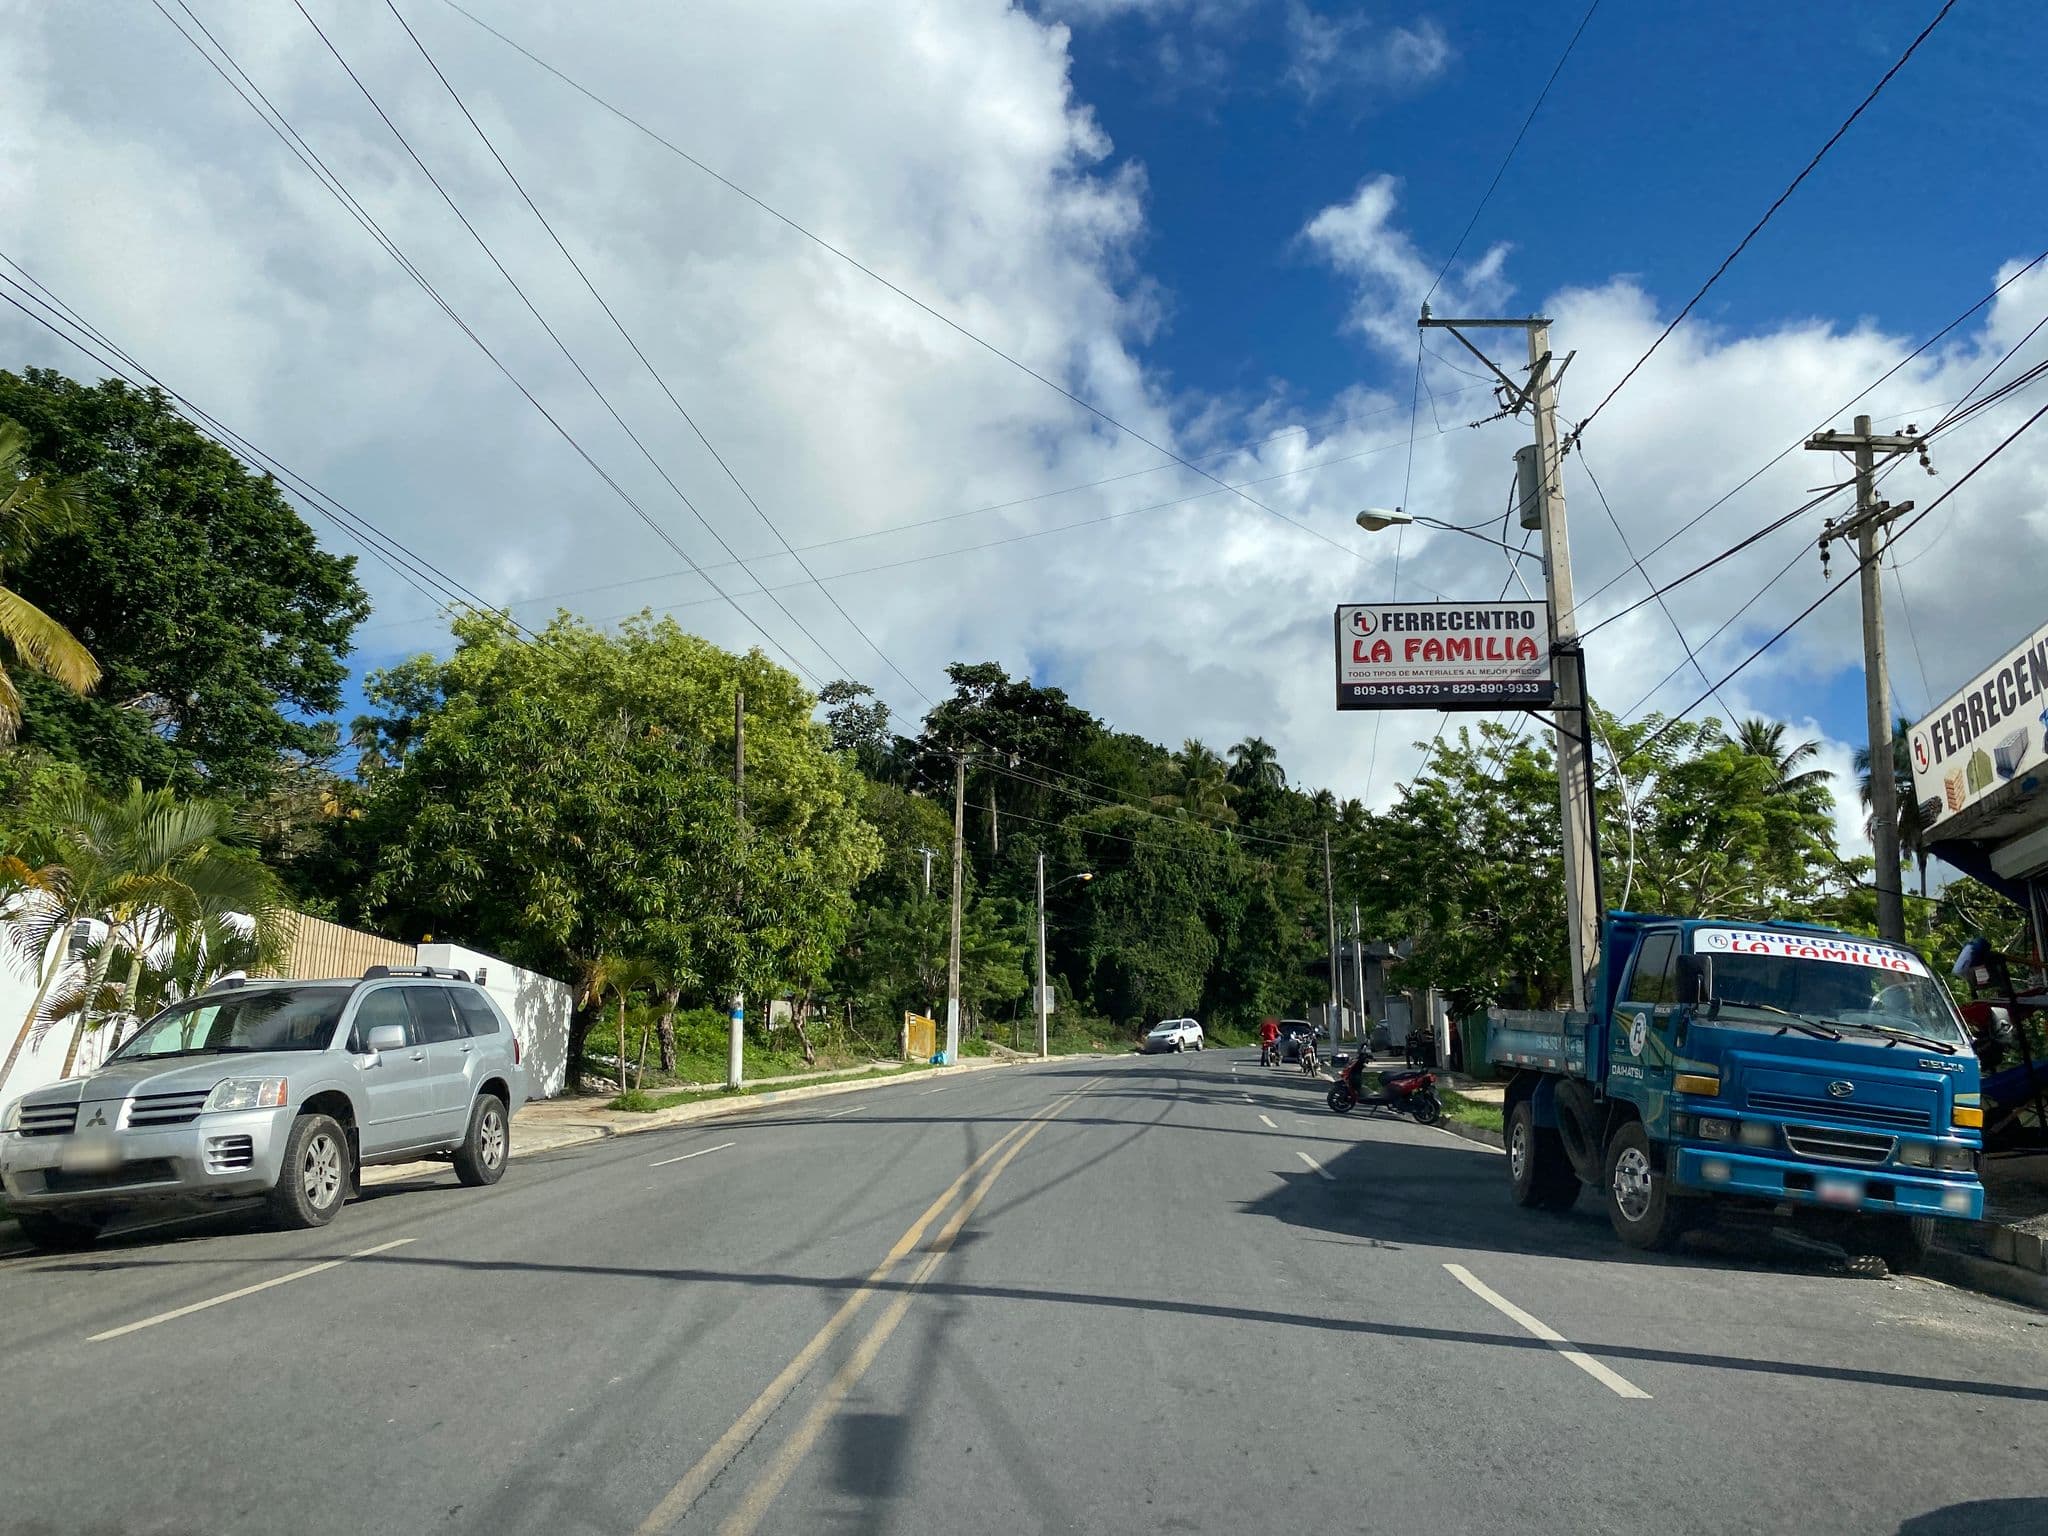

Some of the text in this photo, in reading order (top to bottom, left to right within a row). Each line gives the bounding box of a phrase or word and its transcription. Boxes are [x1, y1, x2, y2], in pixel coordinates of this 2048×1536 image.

[1382, 610, 1535, 632] FERRECENTRO
[1353, 636, 1539, 664] LA FAMILIA
[1412, 669, 1464, 677] MATERIALES
[1479, 668, 1508, 676] MEJOR
[1510, 667, 1541, 675] PRECIO
[1354, 683, 1539, 696] 809-816-8373 829-890-9933
[1930, 637, 2048, 765] FERRECEN
[1731, 932, 1908, 960] FERRECENTRO
[1732, 941, 1911, 971] LA FAMILIA
[1611, 1064, 1644, 1080] DAIHATSU
